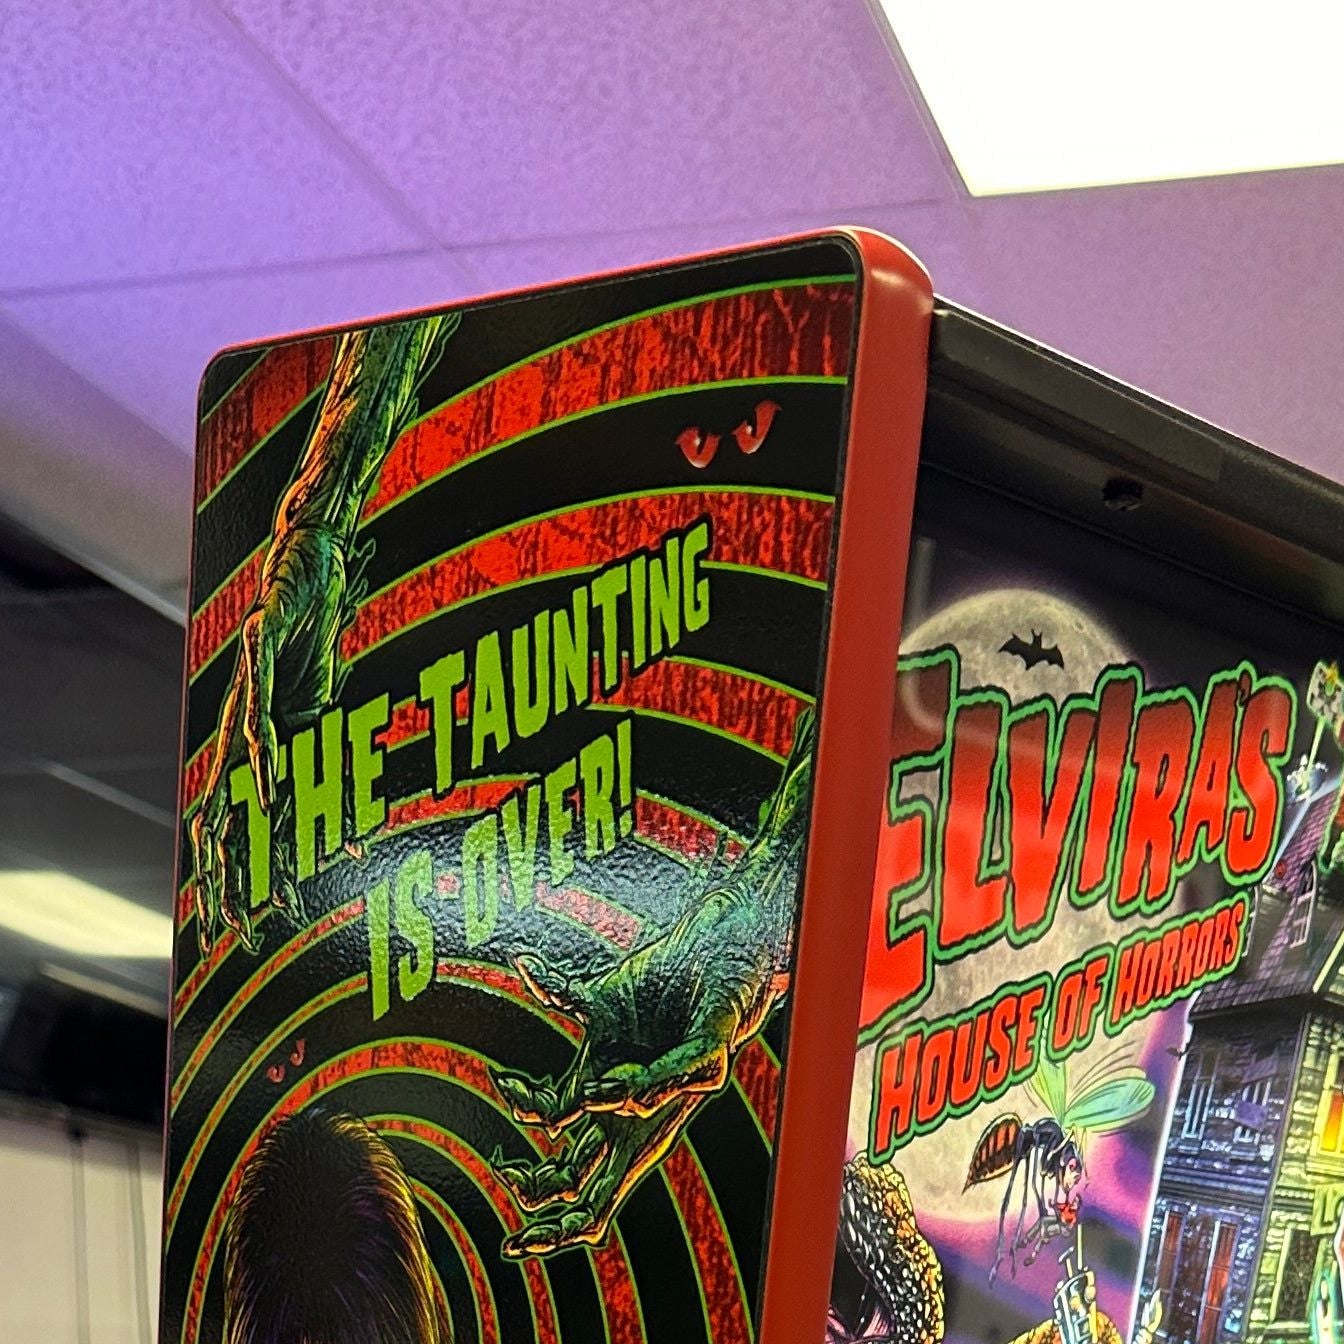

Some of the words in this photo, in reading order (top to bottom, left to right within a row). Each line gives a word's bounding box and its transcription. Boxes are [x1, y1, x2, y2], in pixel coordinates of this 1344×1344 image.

[229, 693, 394, 907] THE
[420, 524, 711, 792] TAUNTING
[366, 850, 434, 1020] IS
[464, 719, 634, 947] OVER!
[873, 984, 1050, 1158] HOUSE
[1053, 955, 1110, 1054] OF
[1113, 901, 1247, 1028] HORRORS
